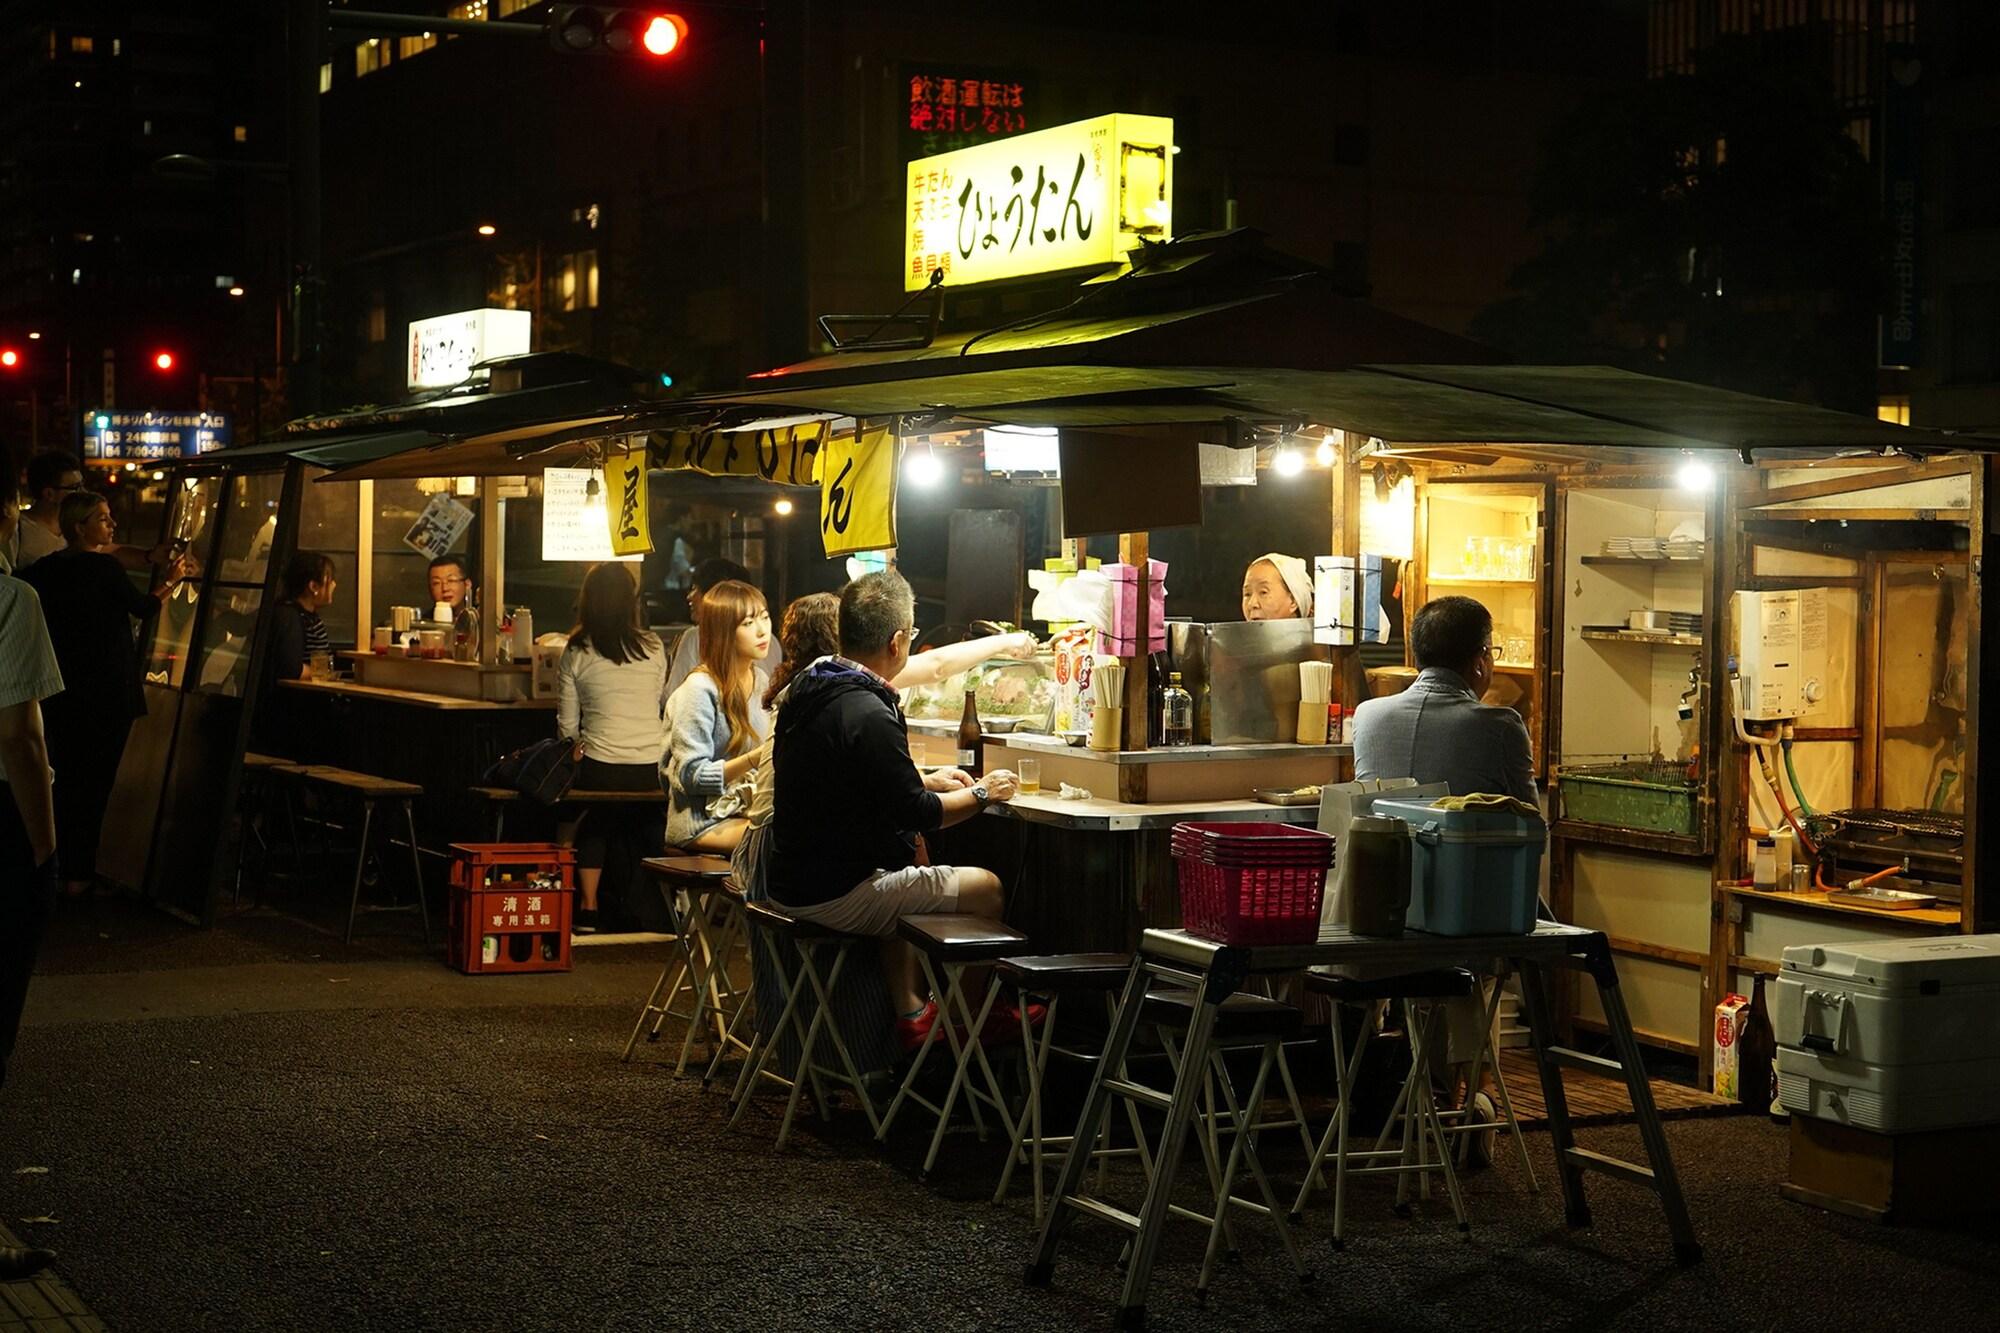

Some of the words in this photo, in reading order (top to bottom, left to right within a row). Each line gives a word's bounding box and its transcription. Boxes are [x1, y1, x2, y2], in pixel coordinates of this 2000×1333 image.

[911, 76, 1024, 107] 飲酒運転は
[910, 104, 1026, 133] 絶対しない
[914, 168, 954, 195] 牛たん
[958, 152, 1093, 260] ひょうたん
[503, 896, 542, 913] 清酒
